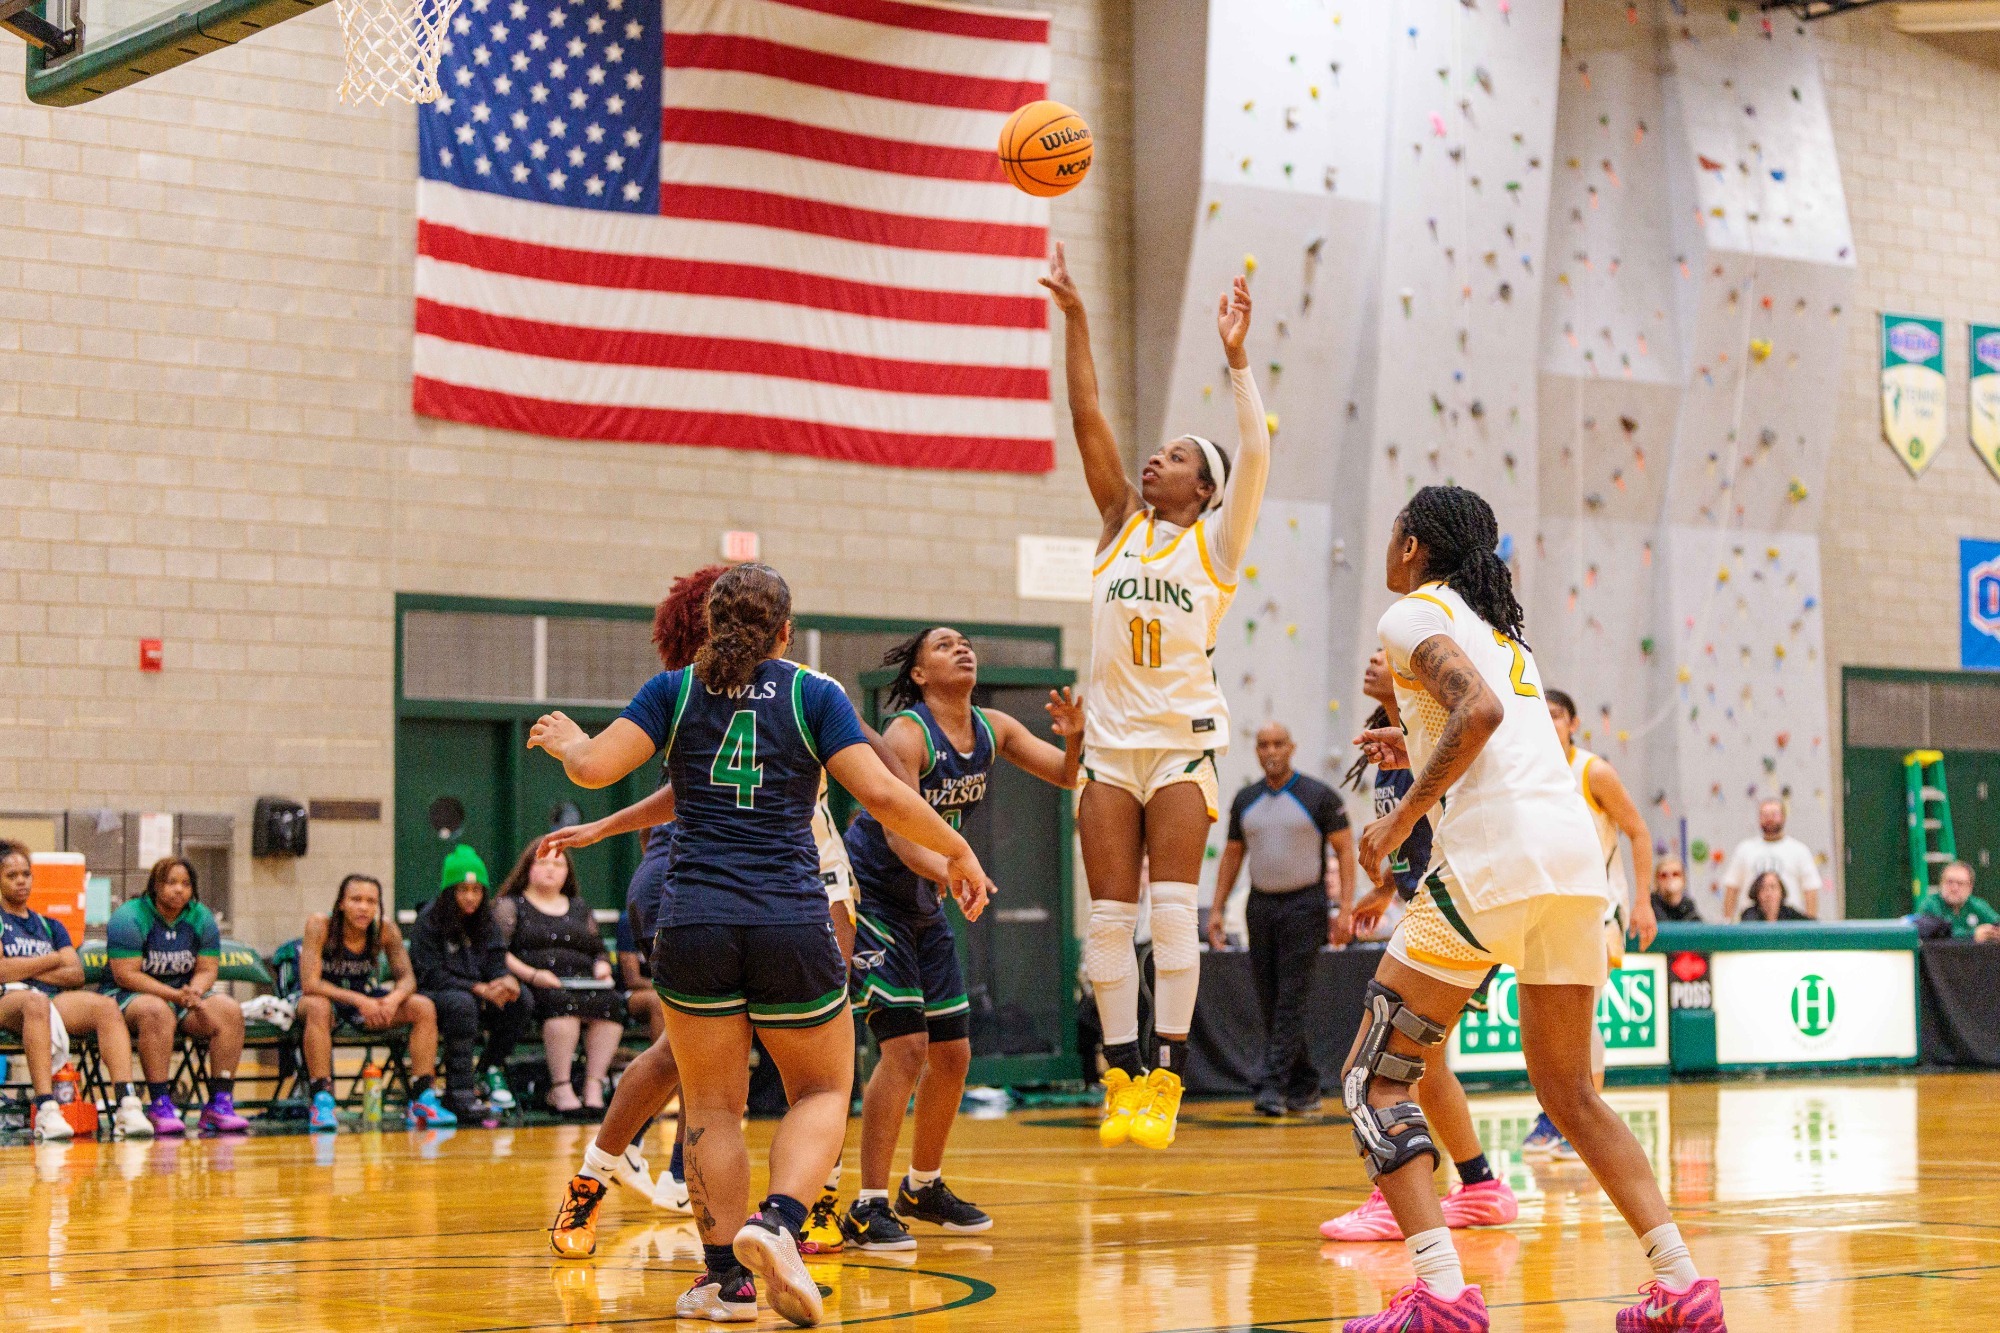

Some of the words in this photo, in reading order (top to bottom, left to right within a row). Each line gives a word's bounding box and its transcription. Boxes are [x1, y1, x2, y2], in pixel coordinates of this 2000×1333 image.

[1040, 127, 1091, 151] Wilson
[1106, 576, 1193, 613] HOLINS
[1129, 616, 1162, 668] 11
[1492, 628, 1540, 699] 2
[710, 709, 763, 809] 4
[1464, 974, 1653, 1027] HONS
[1796, 979, 1832, 1030] H
[1466, 1026, 1650, 1048] UNIITY
